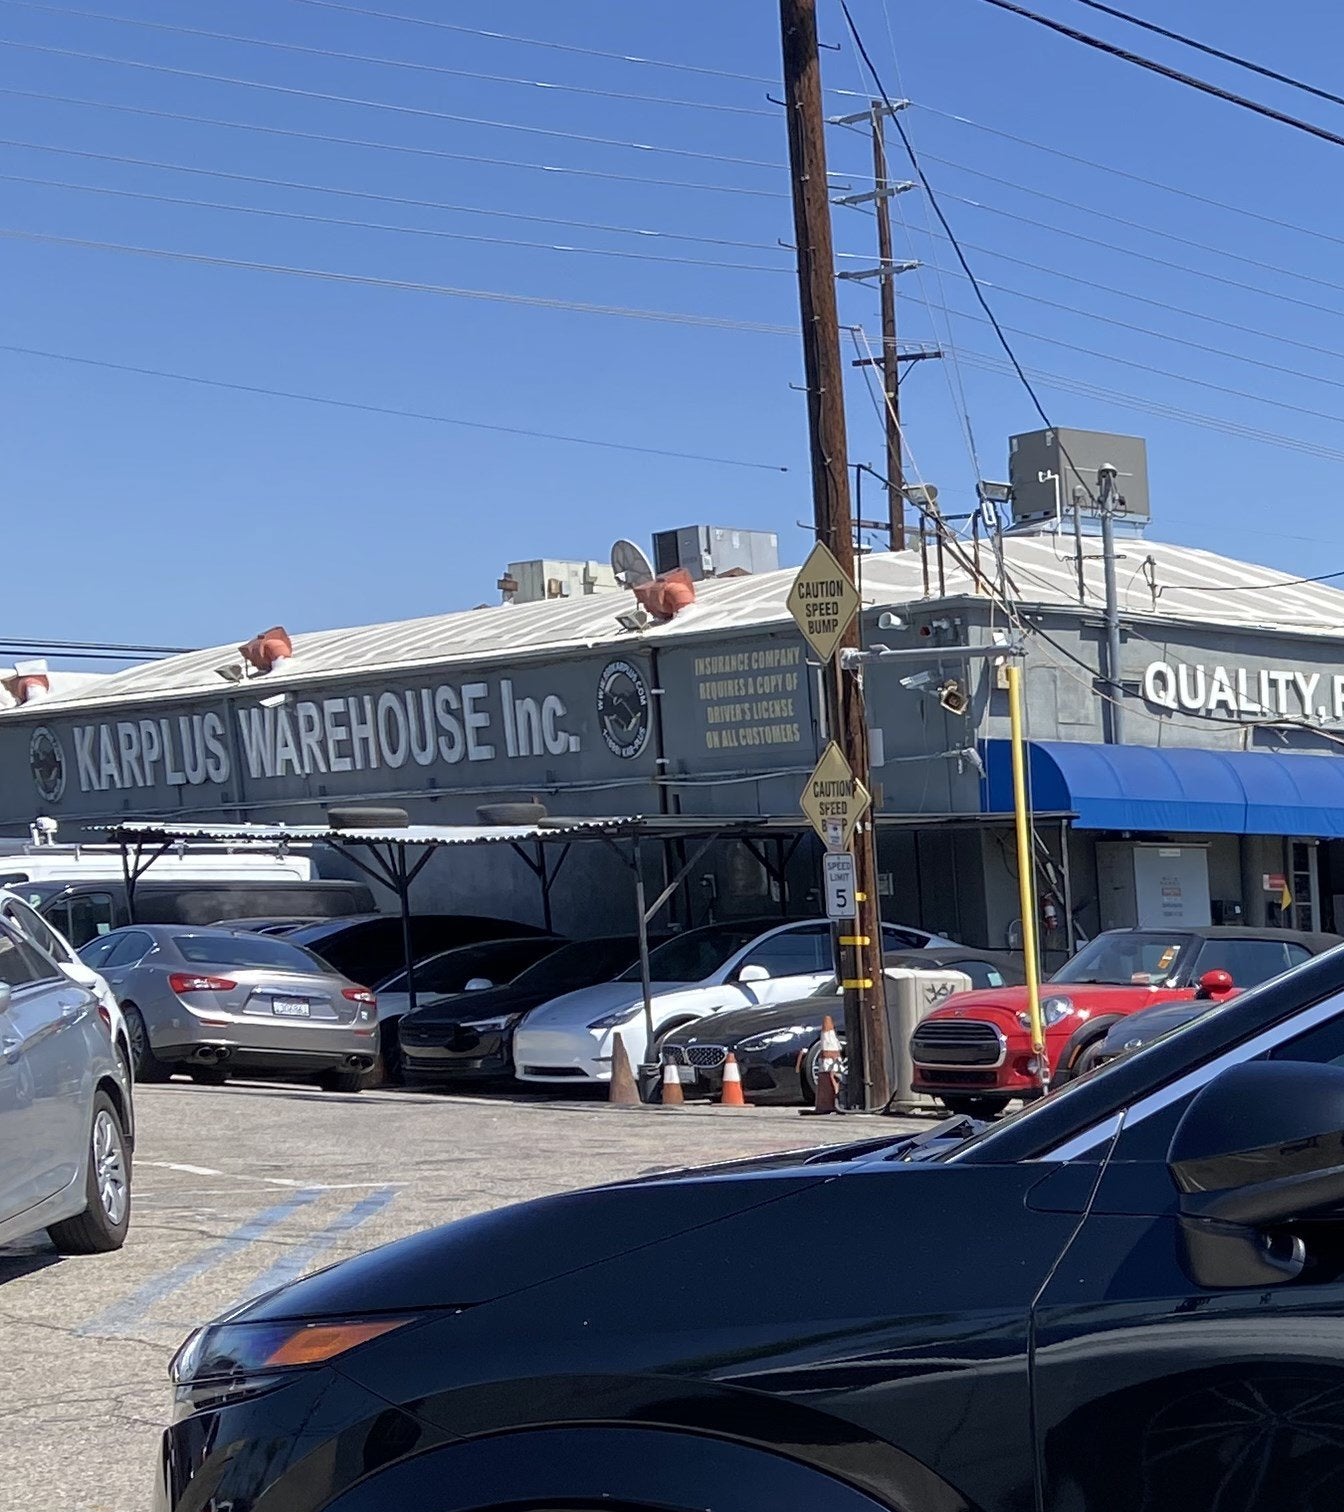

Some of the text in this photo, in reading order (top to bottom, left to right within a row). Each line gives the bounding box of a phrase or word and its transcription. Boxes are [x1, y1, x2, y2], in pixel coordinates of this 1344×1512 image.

[797, 580, 844, 599] CAUTION
[805, 602, 839, 617] SPEED
[808, 619, 839, 635] BUMP
[695, 646, 800, 676] INSURANCE COMPANY
[699, 672, 798, 700] REQUIRES A COPY OF
[1143, 660, 1327, 718] QUALITY,
[706, 698, 794, 724] DRIVER'S LICENSE
[72, 711, 231, 792] KARPLUS
[238, 681, 496, 779] WAREHOUSE
[500, 679, 581, 758] Inc.
[705, 723, 800, 749] ON ALL CUSTOMERS
[812, 779, 853, 798] CAUTION
[821, 819, 848, 833] BP
[827, 861, 851, 871] SPEED
[829, 873, 850, 882] LIMIT
[836, 889, 847, 908] 5
